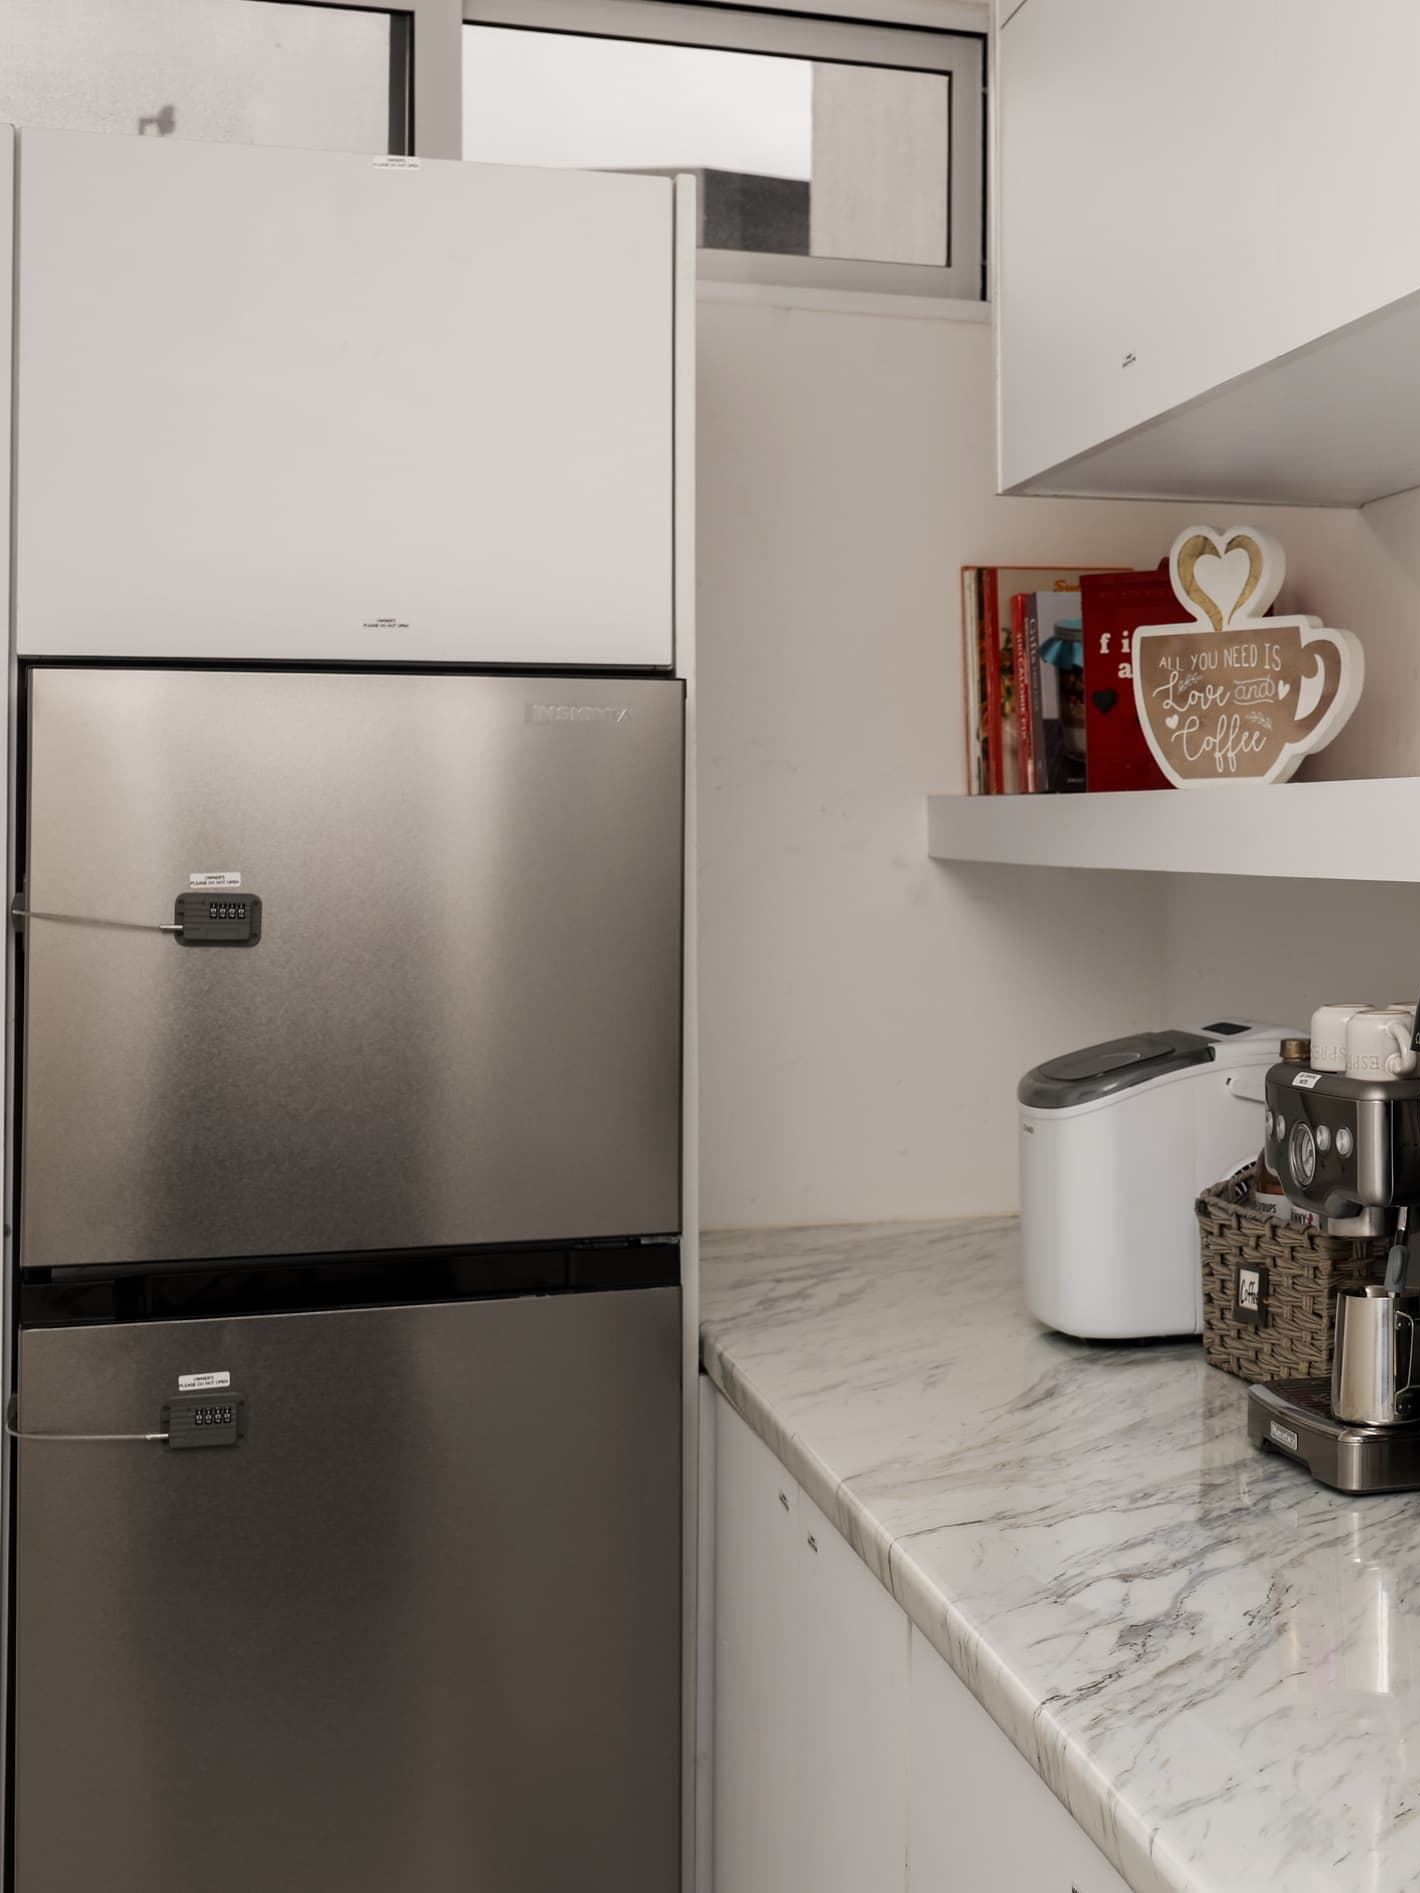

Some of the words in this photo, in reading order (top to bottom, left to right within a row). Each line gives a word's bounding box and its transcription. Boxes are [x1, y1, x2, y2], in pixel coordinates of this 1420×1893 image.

[1099, 630, 1130, 654] fi
[1118, 662, 1133, 678] a
[1159, 655, 1184, 671] ALL
[1190, 650, 1219, 671] YOU
[1223, 643, 1258, 668] NEED
[1263, 643, 1282, 671] IS
[1152, 670, 1231, 712] Love
[1234, 674, 1276, 702] and
[1171, 713, 1267, 773] Coffee
